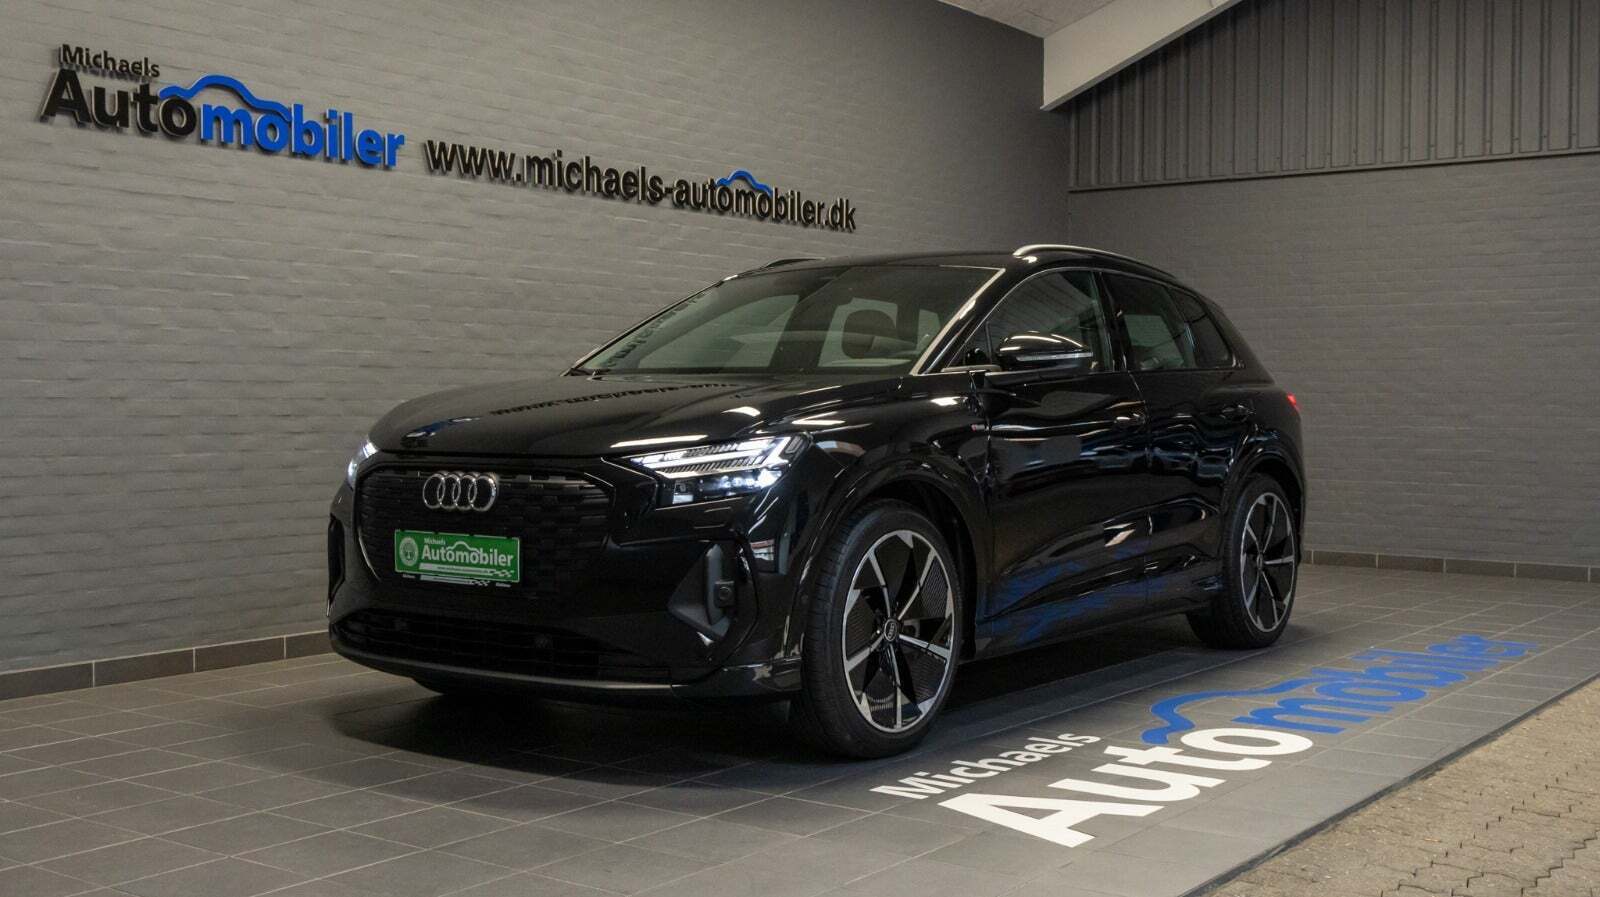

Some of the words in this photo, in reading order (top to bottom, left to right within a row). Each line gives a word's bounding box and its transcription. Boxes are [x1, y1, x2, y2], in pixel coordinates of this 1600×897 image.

[57, 43, 161, 79] Michaels
[40, 68, 405, 168] Automobiler
[424, 139, 857, 232] www.michaels-automobiler.dk
[421, 544, 514, 567] Automobiler
[870, 729, 1101, 800] Michaels
[938, 634, 1538, 848] Automobiler
